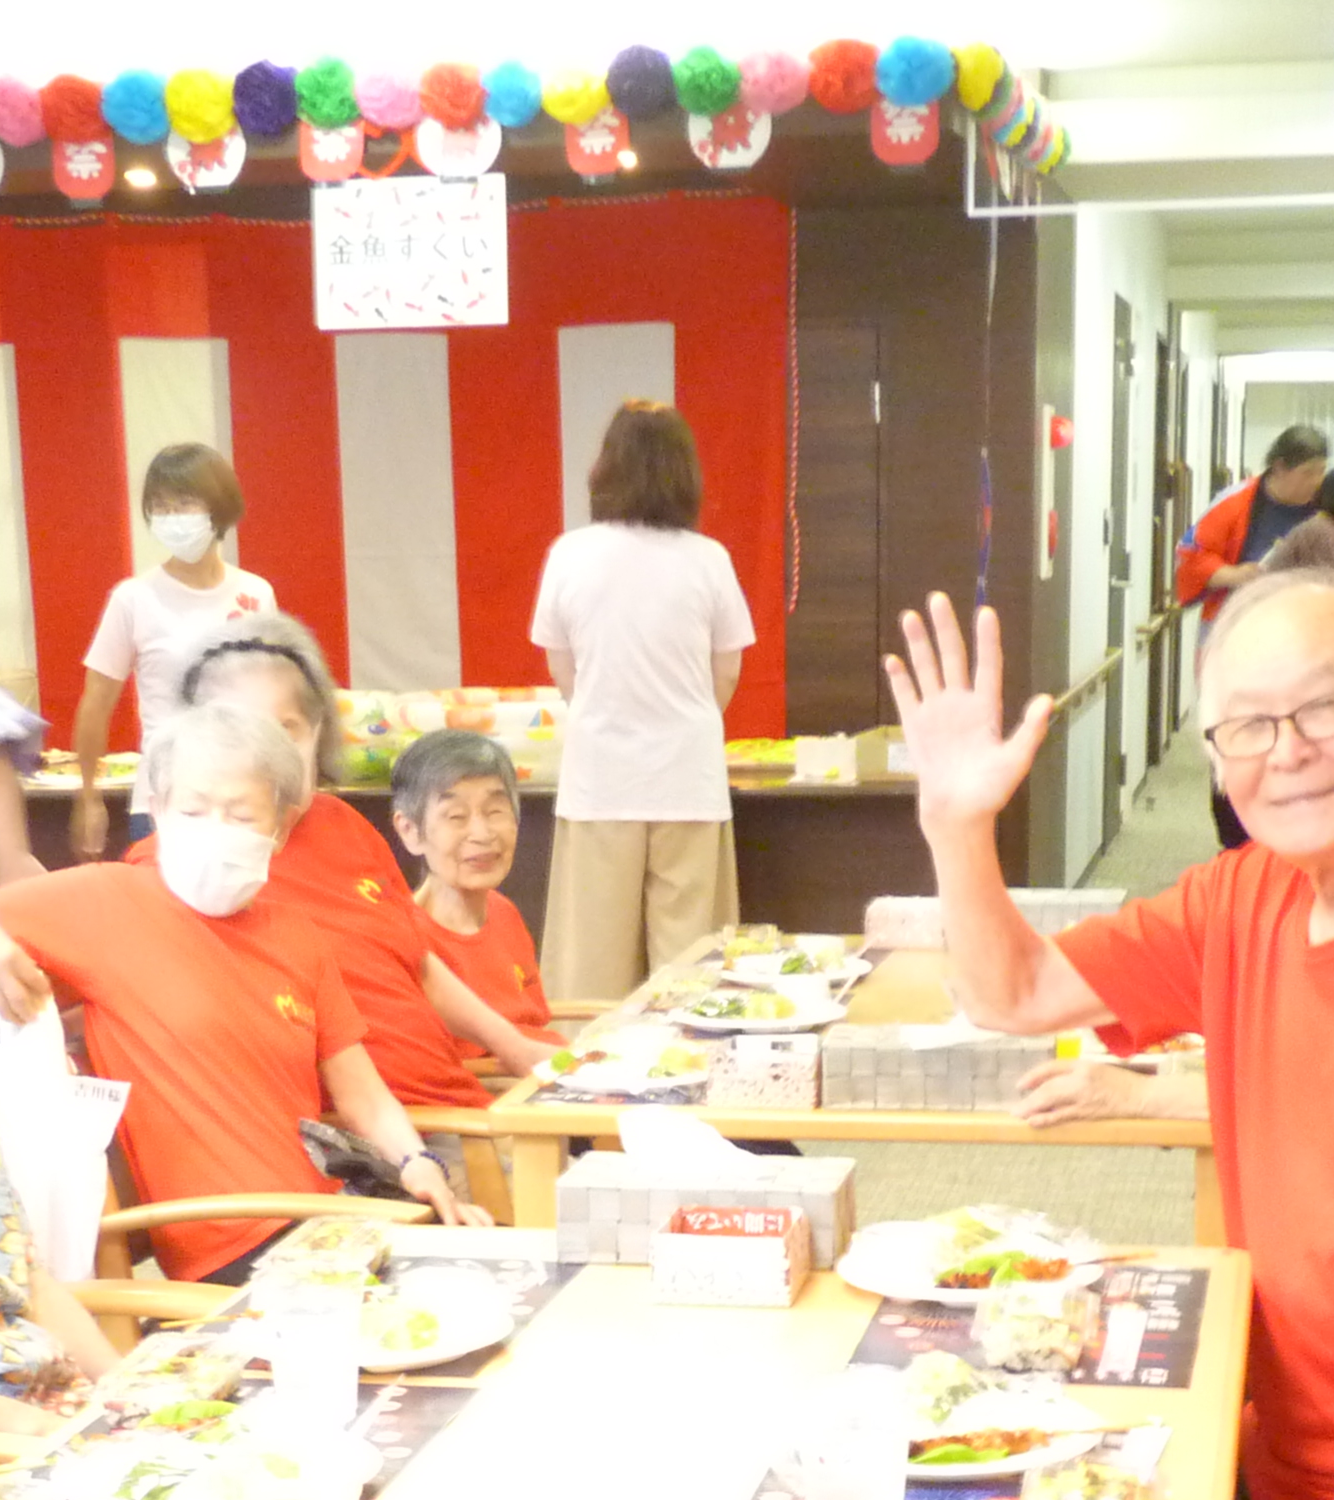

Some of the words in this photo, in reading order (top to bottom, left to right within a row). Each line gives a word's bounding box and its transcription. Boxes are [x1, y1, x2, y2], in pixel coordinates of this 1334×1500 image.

[329, 233, 488, 267] 金魚すくい
